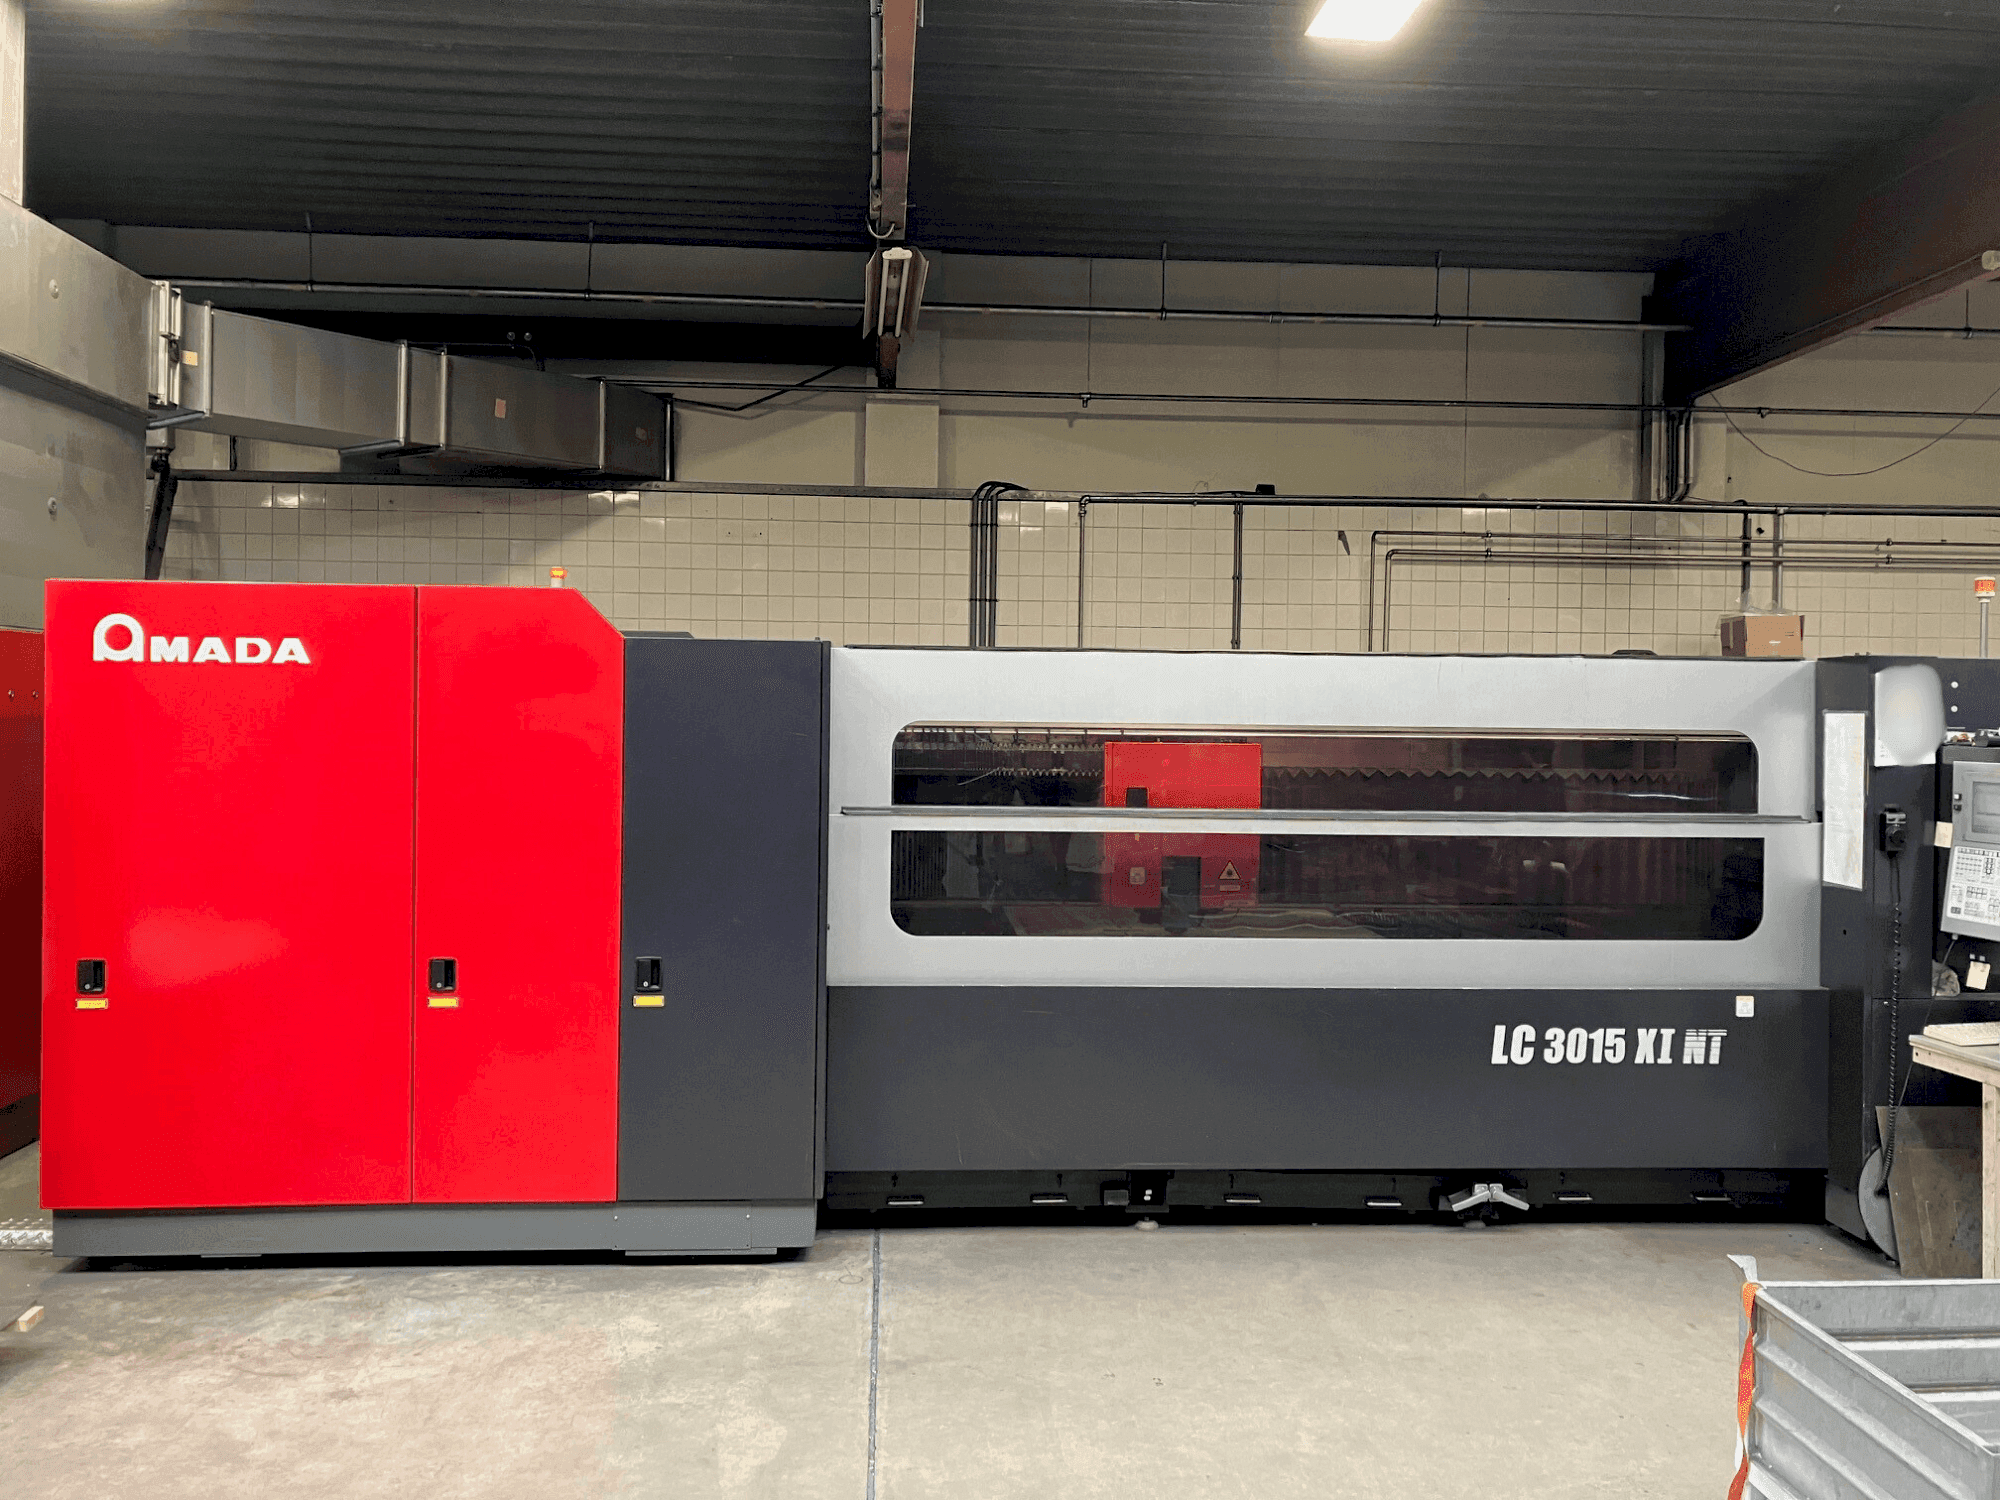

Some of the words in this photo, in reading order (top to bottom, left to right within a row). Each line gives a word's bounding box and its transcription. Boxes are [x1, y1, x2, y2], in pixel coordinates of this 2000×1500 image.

[93, 613, 311, 664] AMADA
[1491, 1024, 1536, 1065] LC
[1543, 1027, 1626, 1064] 3015
[1634, 1028, 1676, 1064] XI
[1682, 1029, 1728, 1065] NT
